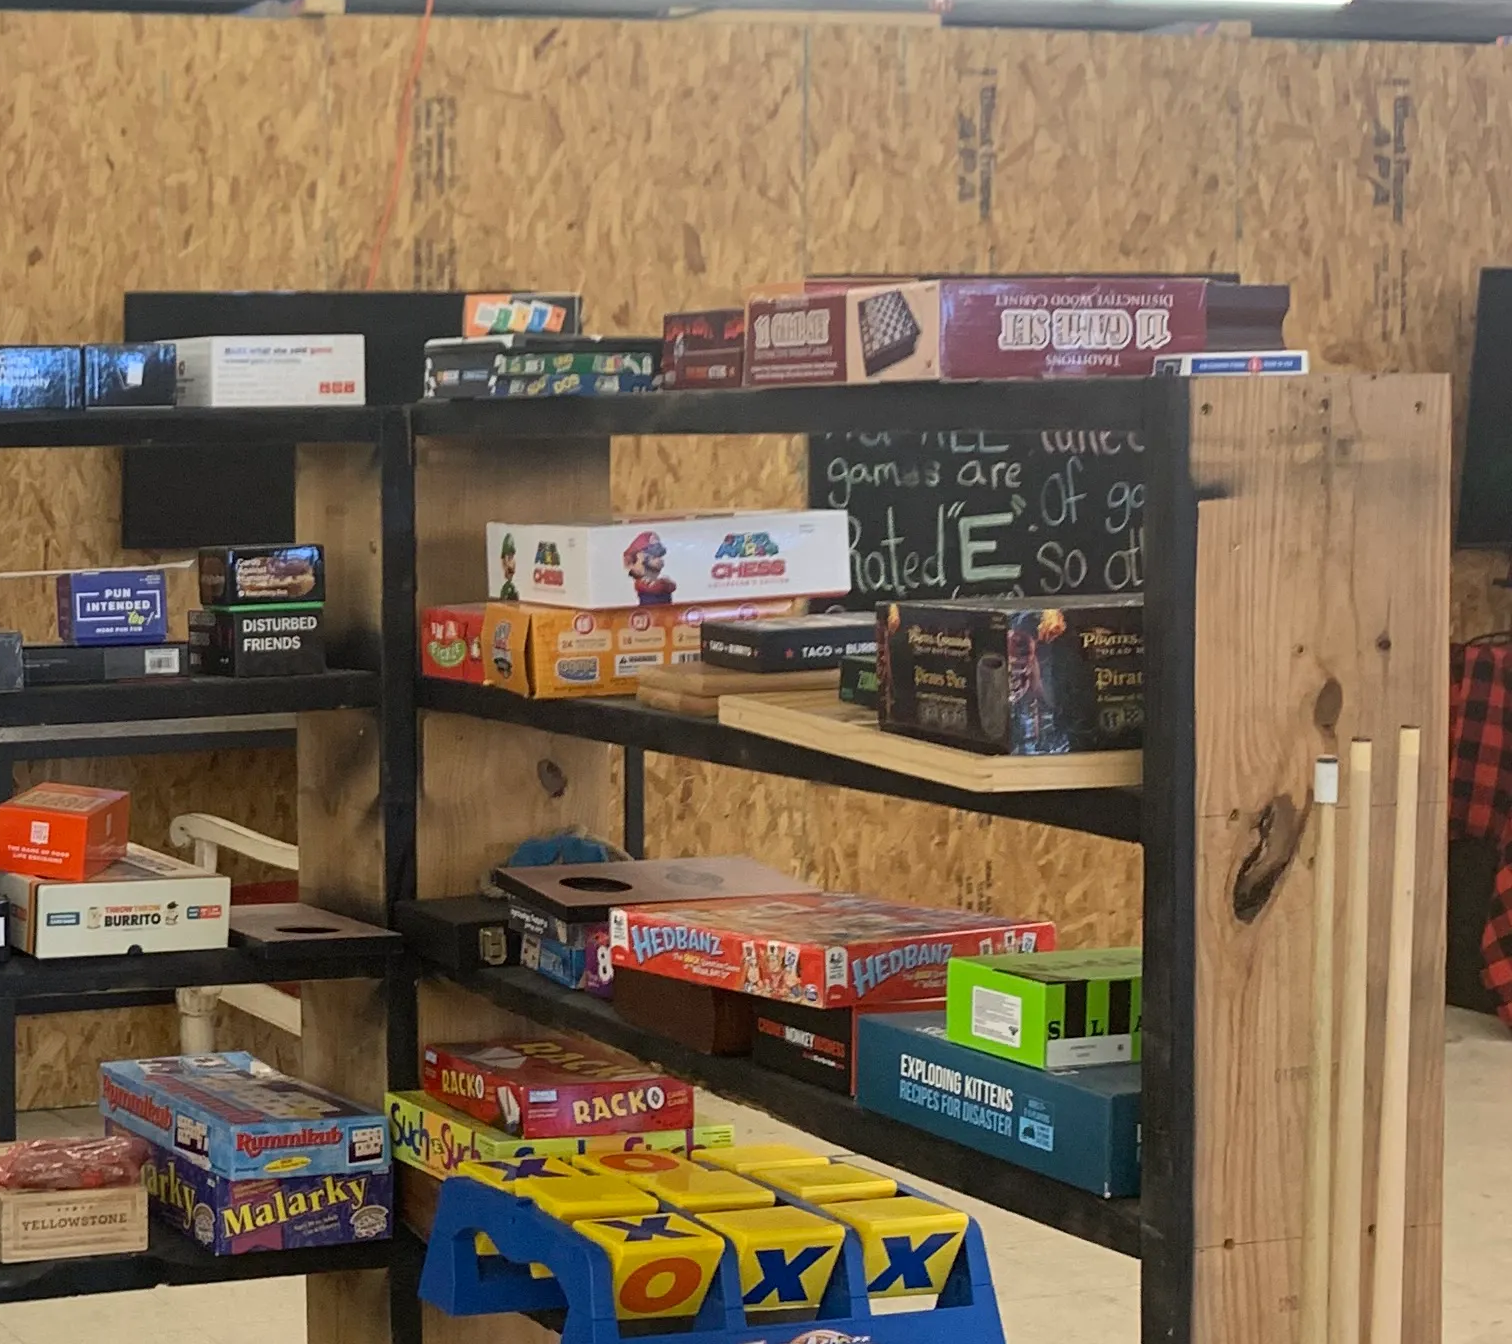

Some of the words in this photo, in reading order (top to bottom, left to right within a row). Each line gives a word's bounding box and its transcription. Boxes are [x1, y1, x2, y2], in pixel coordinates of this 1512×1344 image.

[1049, 294, 1094, 308] WOOD
[998, 308, 1051, 351] SET
[1052, 307, 1133, 350] GAME
[956, 459, 1022, 490] are
[710, 559, 786, 580] CHESS
[86, 599, 151, 612] INTENDED
[104, 588, 132, 599] PUN
[242, 616, 318, 632] DISTURBED
[243, 635, 302, 652] FRIENDS
[802, 645, 833, 658] TACO
[104, 912, 162, 928] BURRITO
[631, 924, 726, 965] HEDBANZ
[851, 942, 954, 998] HEDBANZ
[900, 1054, 962, 1095] EXPLODING
[964, 1074, 1014, 1113] KITTENS
[103, 1073, 173, 1132] Rummikub
[899, 1078, 940, 1112] RECIPES
[940, 1092, 961, 1120] FOR
[962, 1099, 1013, 1137] DISASTER
[236, 1122, 343, 1154] Rummikub
[21, 1211, 128, 1232] YELLOWSTONE
[222, 1175, 368, 1239] Malarky
